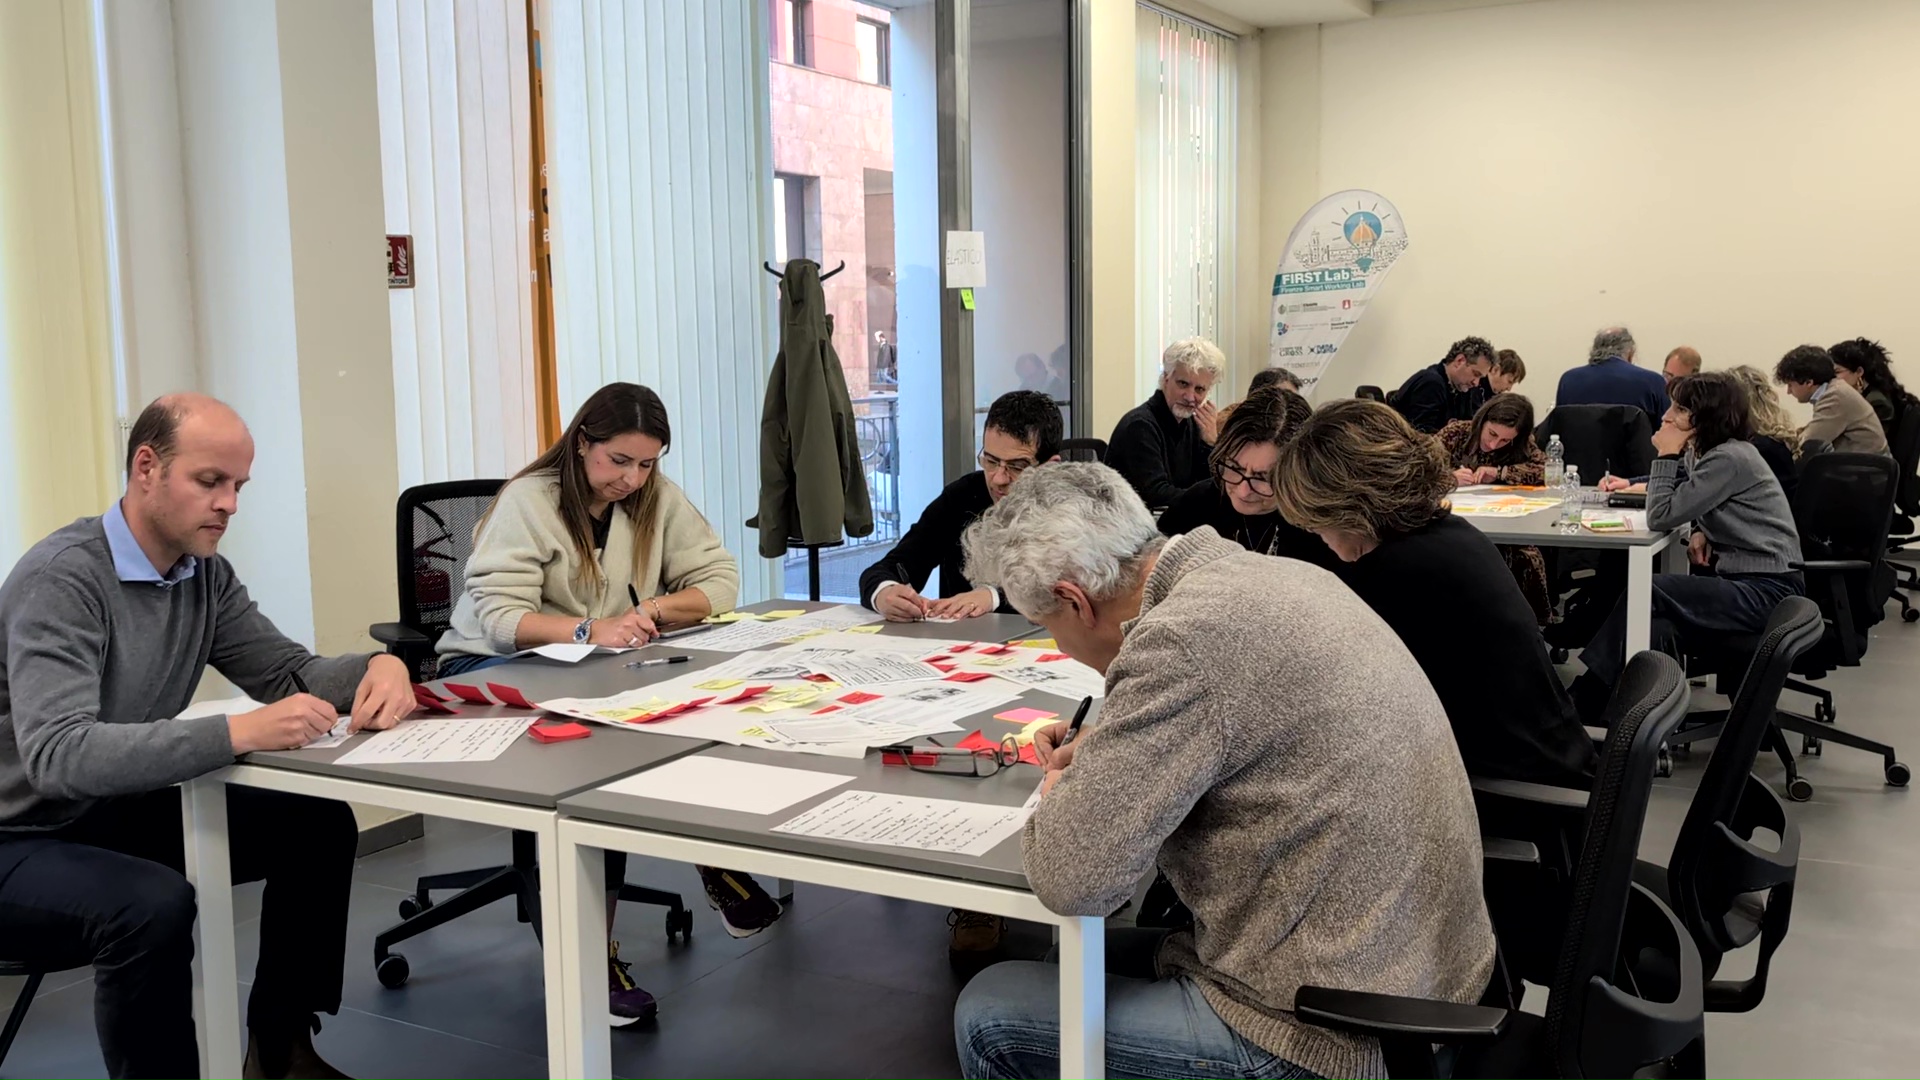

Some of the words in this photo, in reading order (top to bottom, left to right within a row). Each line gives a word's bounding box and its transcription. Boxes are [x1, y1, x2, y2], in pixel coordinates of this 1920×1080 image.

[1281, 271, 1322, 285] FIRST
[1324, 269, 1350, 282] Lab
[1324, 282, 1351, 292] Working
[1352, 280, 1365, 289] Lab
